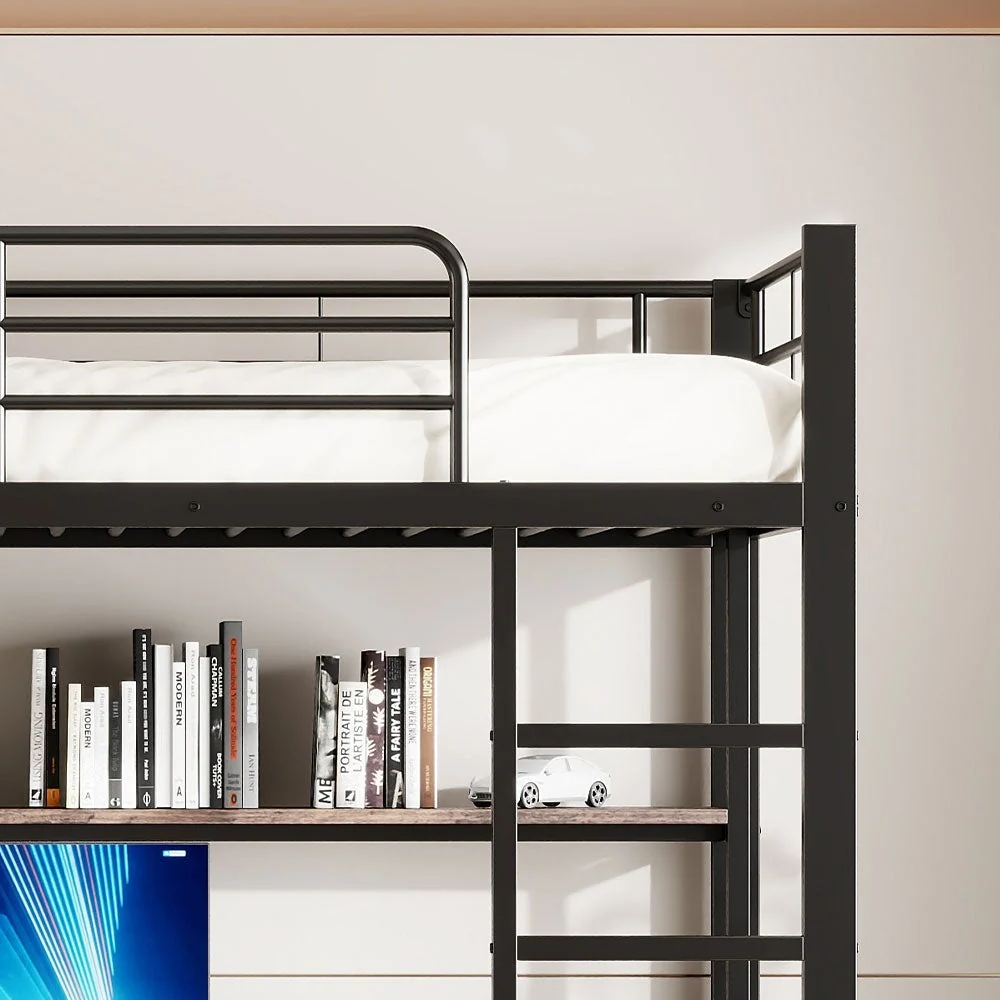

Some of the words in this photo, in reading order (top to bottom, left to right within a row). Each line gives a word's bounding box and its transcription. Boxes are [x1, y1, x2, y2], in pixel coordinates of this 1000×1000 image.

[175, 671, 183, 726] MODERN
[246, 657, 258, 724] STEAM
[341, 690, 352, 707] DE
[354, 689, 364, 705] EN
[390, 688, 401, 717] TALE
[83, 708, 92, 749] MODERN
[340, 710, 351, 774] PORTRAIT
[390, 718, 401, 752] FAIRY
[390, 753, 401, 763] A
